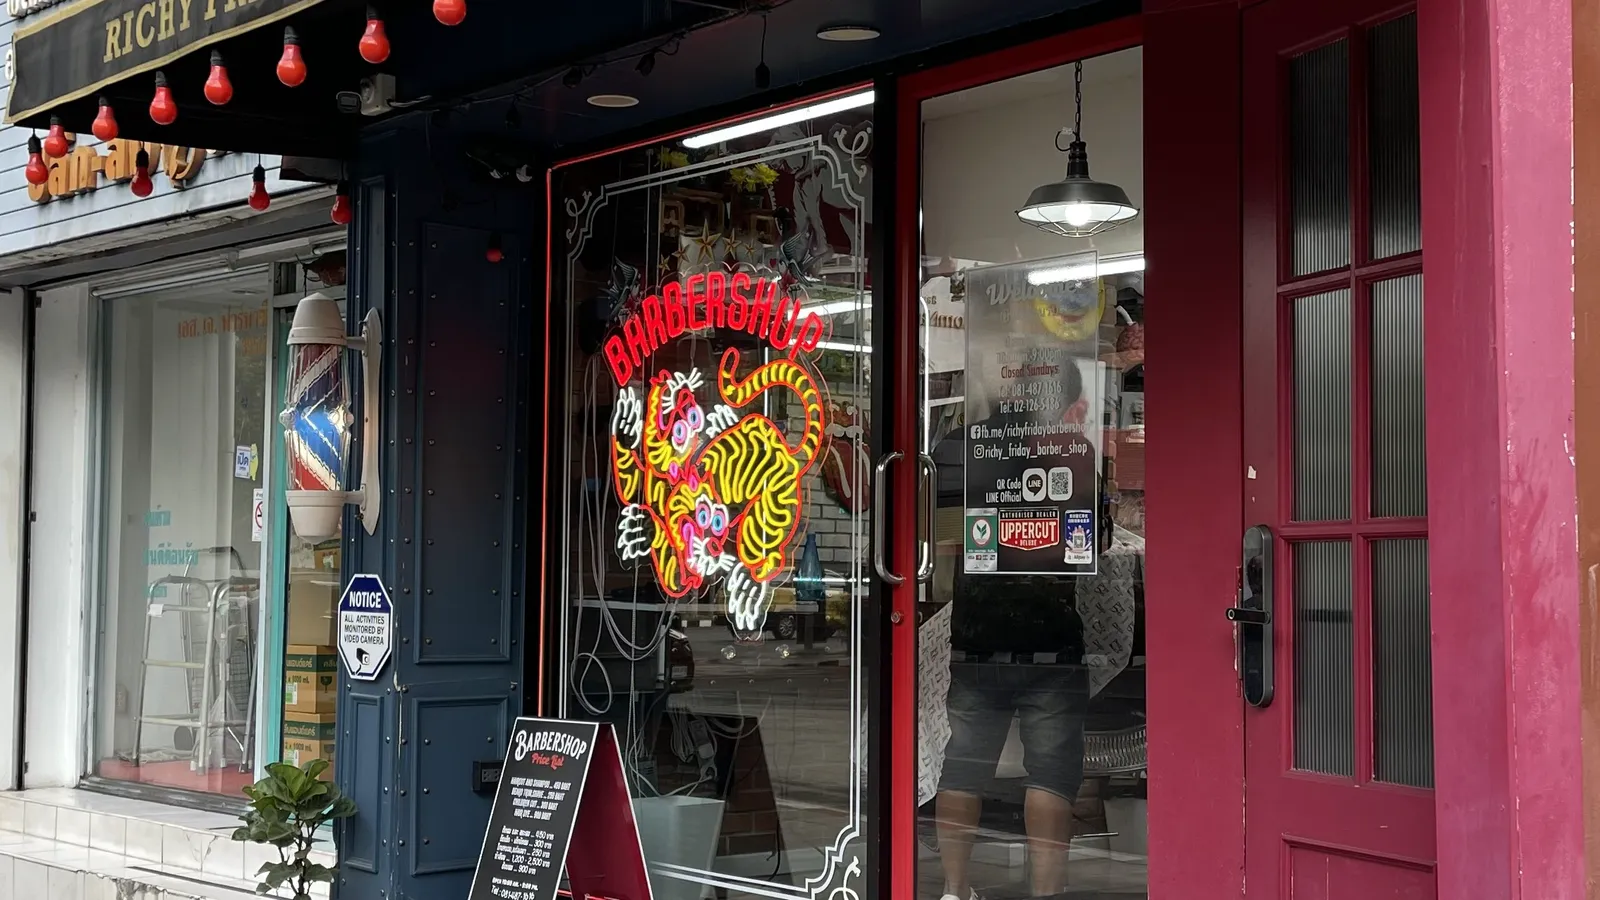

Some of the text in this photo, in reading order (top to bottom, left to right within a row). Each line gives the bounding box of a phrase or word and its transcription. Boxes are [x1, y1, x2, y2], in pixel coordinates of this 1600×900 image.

[103, 0, 190, 63] RICHY
[1000, 362, 1060, 379] Closed Sundays
[1000, 400, 1012, 414] Tel:
[981, 420, 1088, 440] fb.me/richyfridaybarbersho
[985, 439, 1088, 460] richy_friday_barber_shop
[996, 477, 1022, 490] QR Code
[1028, 480, 1042, 488] LINE
[986, 490, 1022, 503] LINE Official
[1001, 522, 1056, 542] UPPERCUT
[349, 591, 382, 608] NOTICE
[344, 614, 385, 624] ALL ACTIVITIES
[344, 625, 384, 635] MONITORED BY
[344, 635, 384, 645] VIDEO CAMERA
[514, 730, 587, 761] BARBERSHOP
[532, 752, 565, 770] Price List
[534, 839, 544, 848] 300
[532, 848, 542, 857] 250
[518, 865, 528, 873] 900
